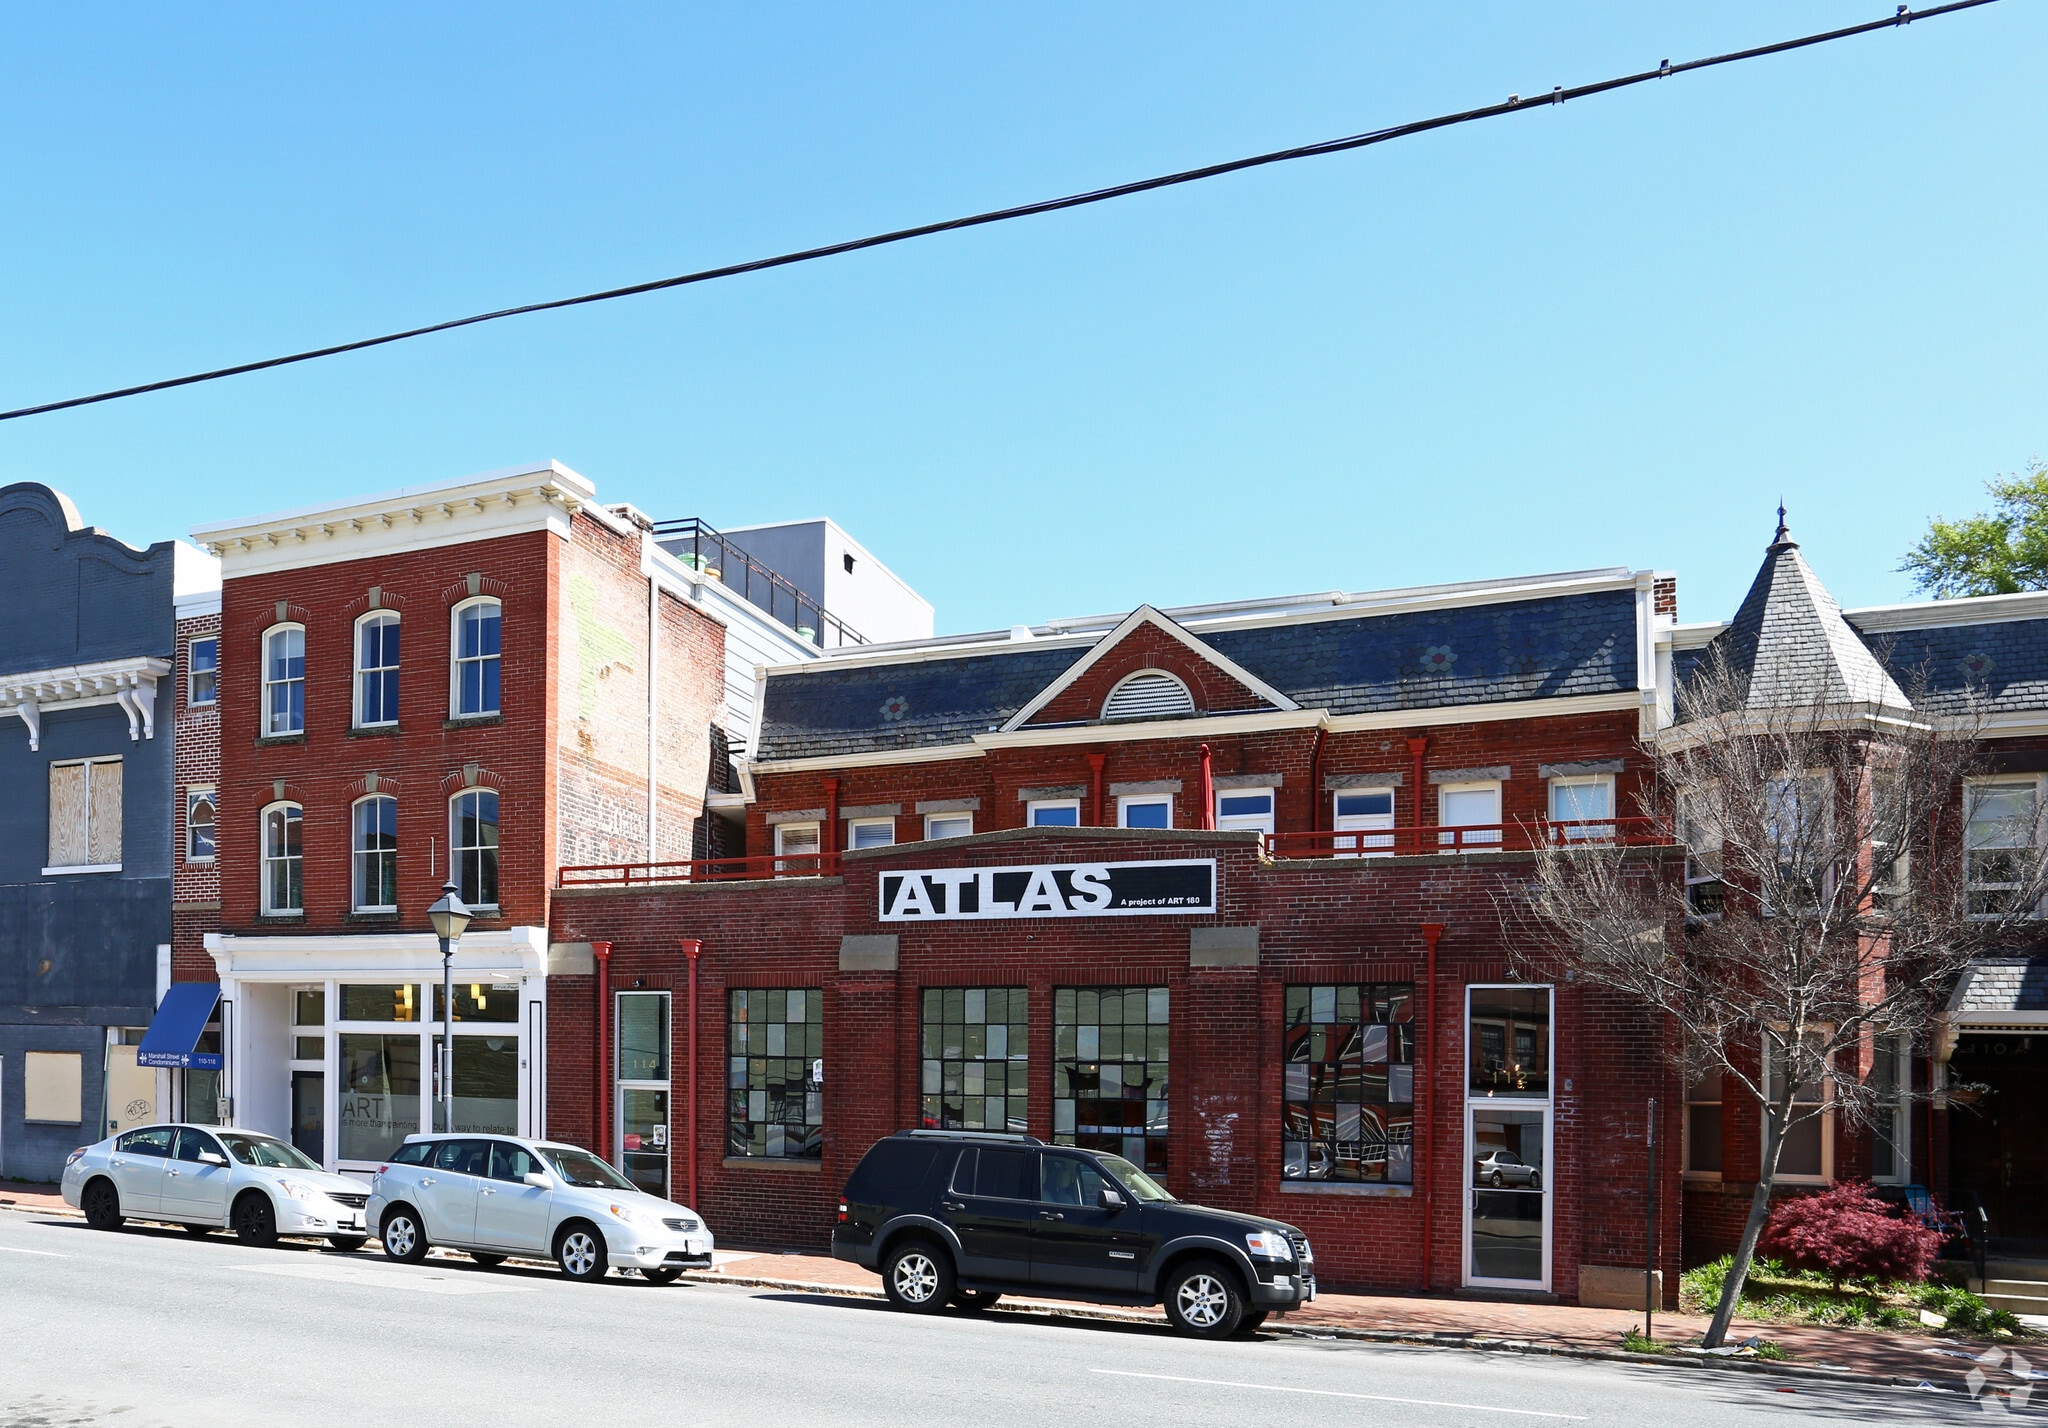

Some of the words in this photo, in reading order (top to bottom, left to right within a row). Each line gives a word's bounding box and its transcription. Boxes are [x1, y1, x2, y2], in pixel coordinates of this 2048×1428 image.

[888, 866, 1113, 916] ATLAS
[1120, 898, 1127, 906] A
[1128, 898, 1156, 907] project
[1157, 897, 1166, 905] of
[1167, 897, 1184, 905] ART
[1186, 896, 1200, 904] 180
[633, 1059, 657, 1069] 114
[1493, 1071, 1528, 1083] 112
[342, 1097, 384, 1119] ART
[482, 1124, 505, 1134] relate
[507, 1125, 515, 1135] to
